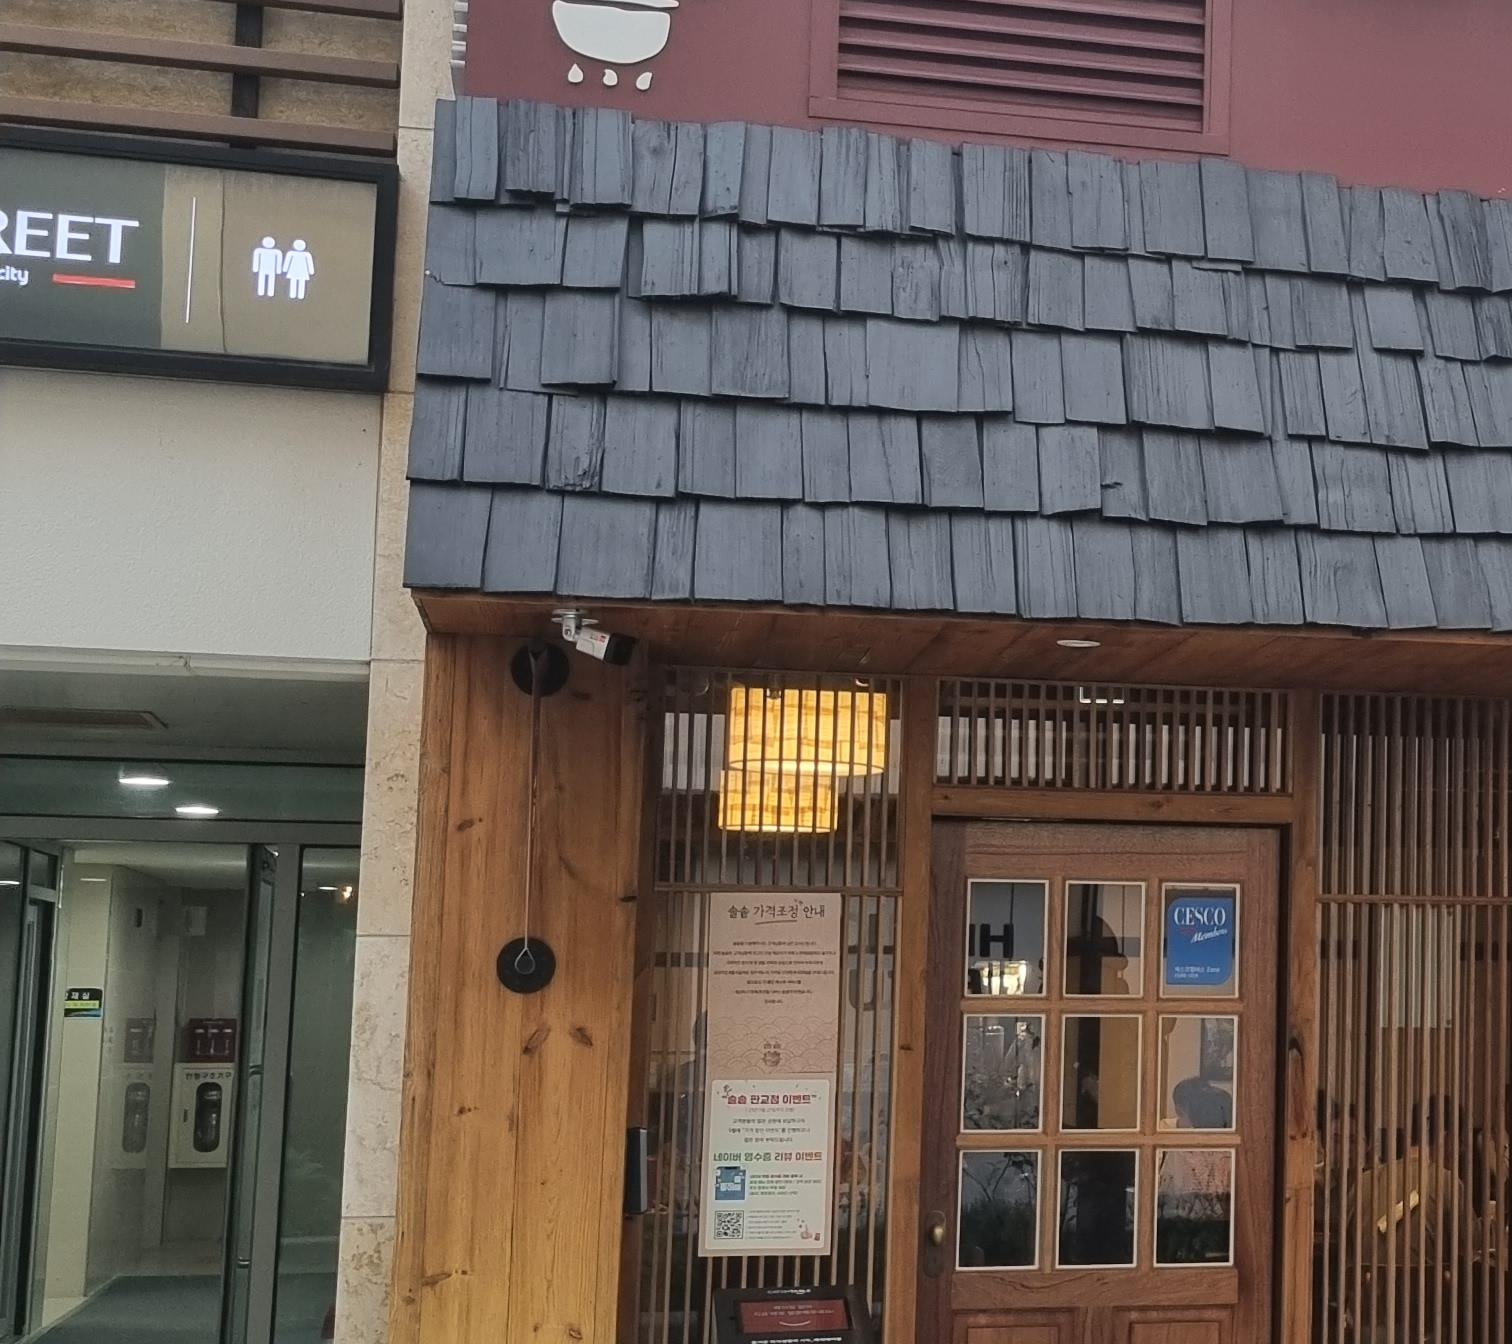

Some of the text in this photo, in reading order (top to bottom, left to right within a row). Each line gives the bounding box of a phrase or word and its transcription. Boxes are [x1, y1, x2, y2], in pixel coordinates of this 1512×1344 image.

[803, 904, 825, 918] 안내
[1173, 906, 1227, 927] CESCO
[713, 1151, 742, 1162] 네이버
